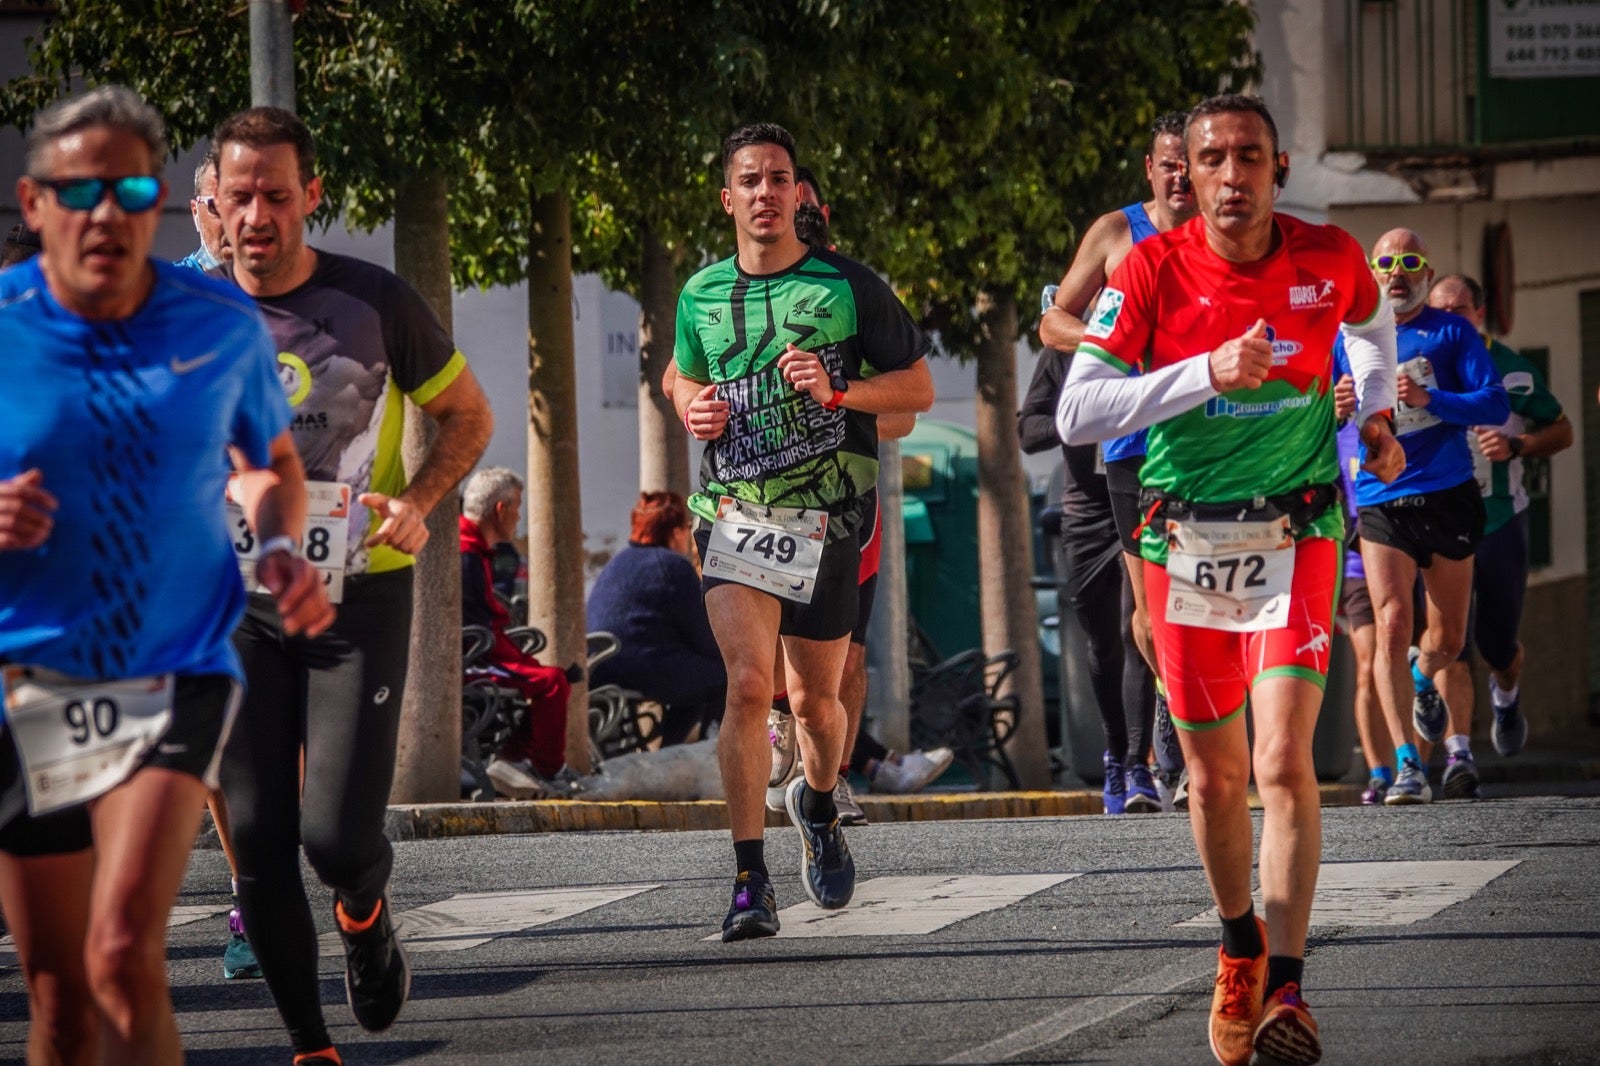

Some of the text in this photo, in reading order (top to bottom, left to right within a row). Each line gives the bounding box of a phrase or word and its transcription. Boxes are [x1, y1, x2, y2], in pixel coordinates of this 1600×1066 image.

[1272, 342, 1294, 353] cho
[292, 411, 328, 425] MAS
[745, 398, 806, 434] MENTE
[741, 416, 809, 459] PIERNAS
[758, 439, 815, 472] RENDIRSE
[735, 527, 797, 564] 749
[1195, 554, 1267, 593] 672
[64, 697, 118, 745] 90
